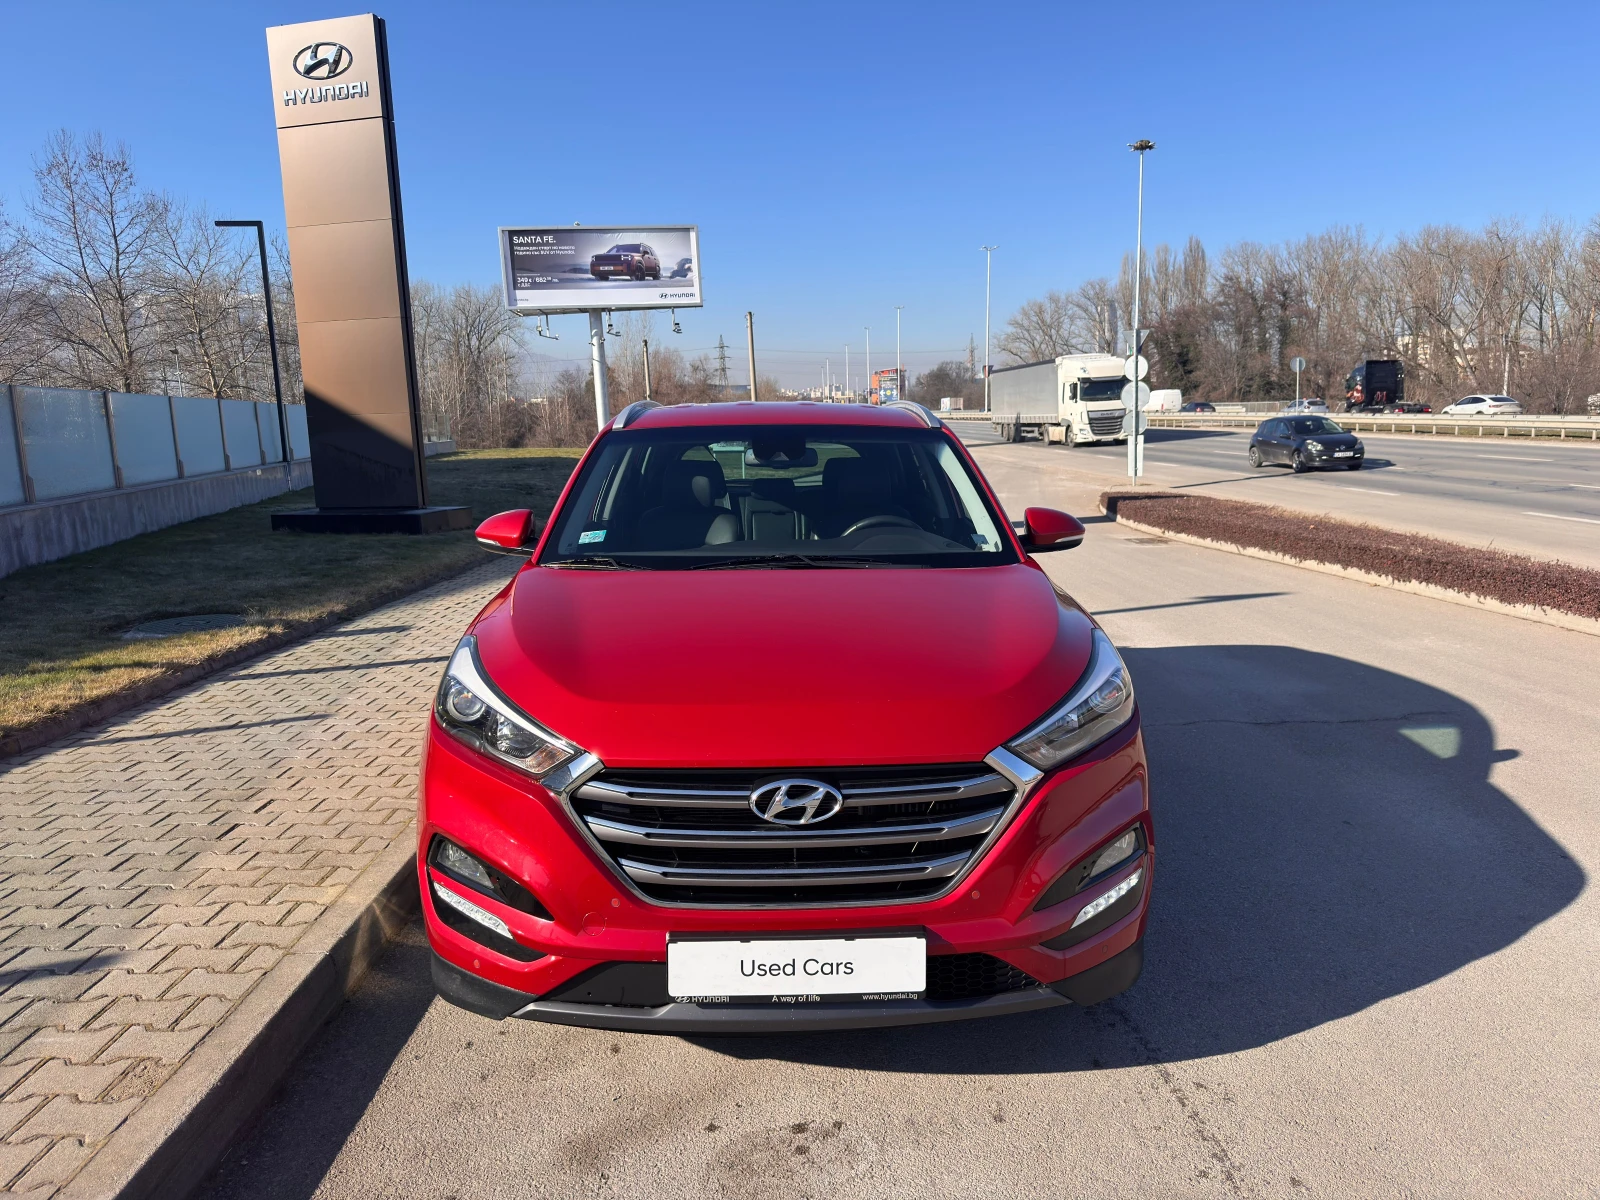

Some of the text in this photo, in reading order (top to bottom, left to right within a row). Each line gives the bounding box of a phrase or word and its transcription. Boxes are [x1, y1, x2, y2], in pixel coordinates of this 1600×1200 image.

[283, 81, 369, 106] HYUNDAI
[740, 958, 854, 977] Used Cars
[780, 996, 796, 1004] way
[808, 994, 820, 1002] life
[862, 992, 918, 1000] www.hyundai.bg
